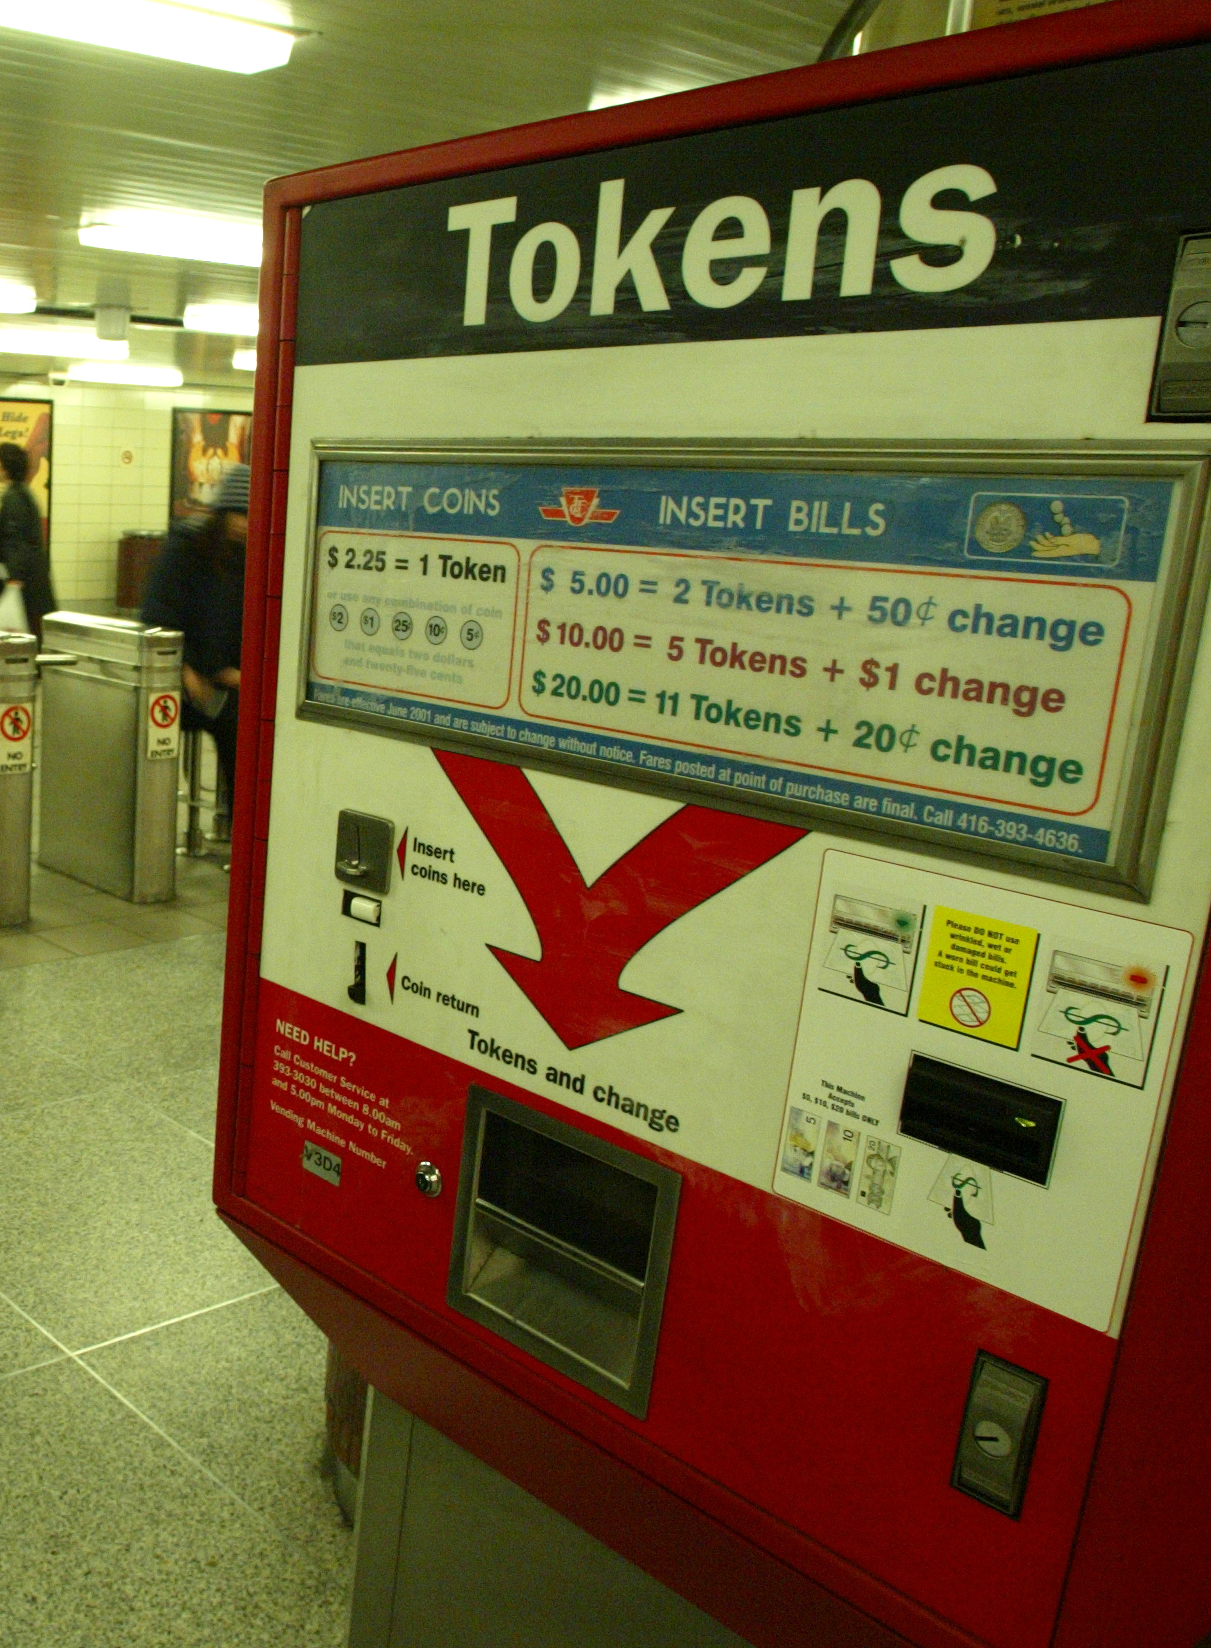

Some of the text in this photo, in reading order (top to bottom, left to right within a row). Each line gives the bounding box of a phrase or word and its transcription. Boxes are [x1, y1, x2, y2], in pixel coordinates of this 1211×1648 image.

[447, 163, 998, 327] Tokens
[1, 411, 28, 422] Hide
[339, 484, 500, 516] INSERT COINS
[659, 494, 887, 537] INSERT BILLS
[420, 554, 429, 576] 1
[438, 554, 506, 583] Token
[385, 596, 457, 614] combination
[461, 603, 474, 615] of
[673, 578, 691, 604] 2
[701, 579, 815, 617] Tokens
[948, 602, 1106, 652] change
[430, 670, 463, 684] cents
[433, 652, 474, 668] dollars
[667, 636, 685, 662] 5
[695, 637, 807, 679] Tokens
[859, 657, 899, 691] $1
[914, 666, 1066, 718] change
[6, 751, 23, 760] NO
[157, 738, 171, 746] NO
[655, 690, 680, 717] 11
[690, 693, 802, 737] Tokens
[930, 735, 1084, 787] change
[409, 706, 431, 722] 2001
[434, 713, 451, 726] and
[453, 717, 468, 730] are
[470, 720, 505, 737] subject
[507, 725, 517, 739] to
[519, 728, 555, 748] change
[558, 735, 596, 755] without
[599, 740, 635, 763] notice.
[639, 750, 671, 770] Fares
[675, 757, 715, 780] posted
[718, 765, 731, 781] at
[734, 769, 766, 790] point
[769, 777, 784, 793] of
[786, 782, 850, 806] purchase
[854, 790, 877, 811] are
[881, 796, 918, 820] final.
[923, 805, 954, 827] Call
[413, 837, 455, 863] Insert
[411, 863, 486, 896] coins here
[946, 919, 971, 933] Please
[401, 975, 480, 1018] Coin return
[276, 1018, 357, 1067] NEED HELP?
[274, 1045, 390, 1109] Call Customer Service at
[467, 1028, 680, 1133] Tokens and change
[271, 1077, 414, 1156] and 5.00pm Monday to Friday.
[319, 1082, 360, 1111] between
[362, 1104, 402, 1132] 8.00am
[270, 1099, 387, 1169] Vending Machine Number
